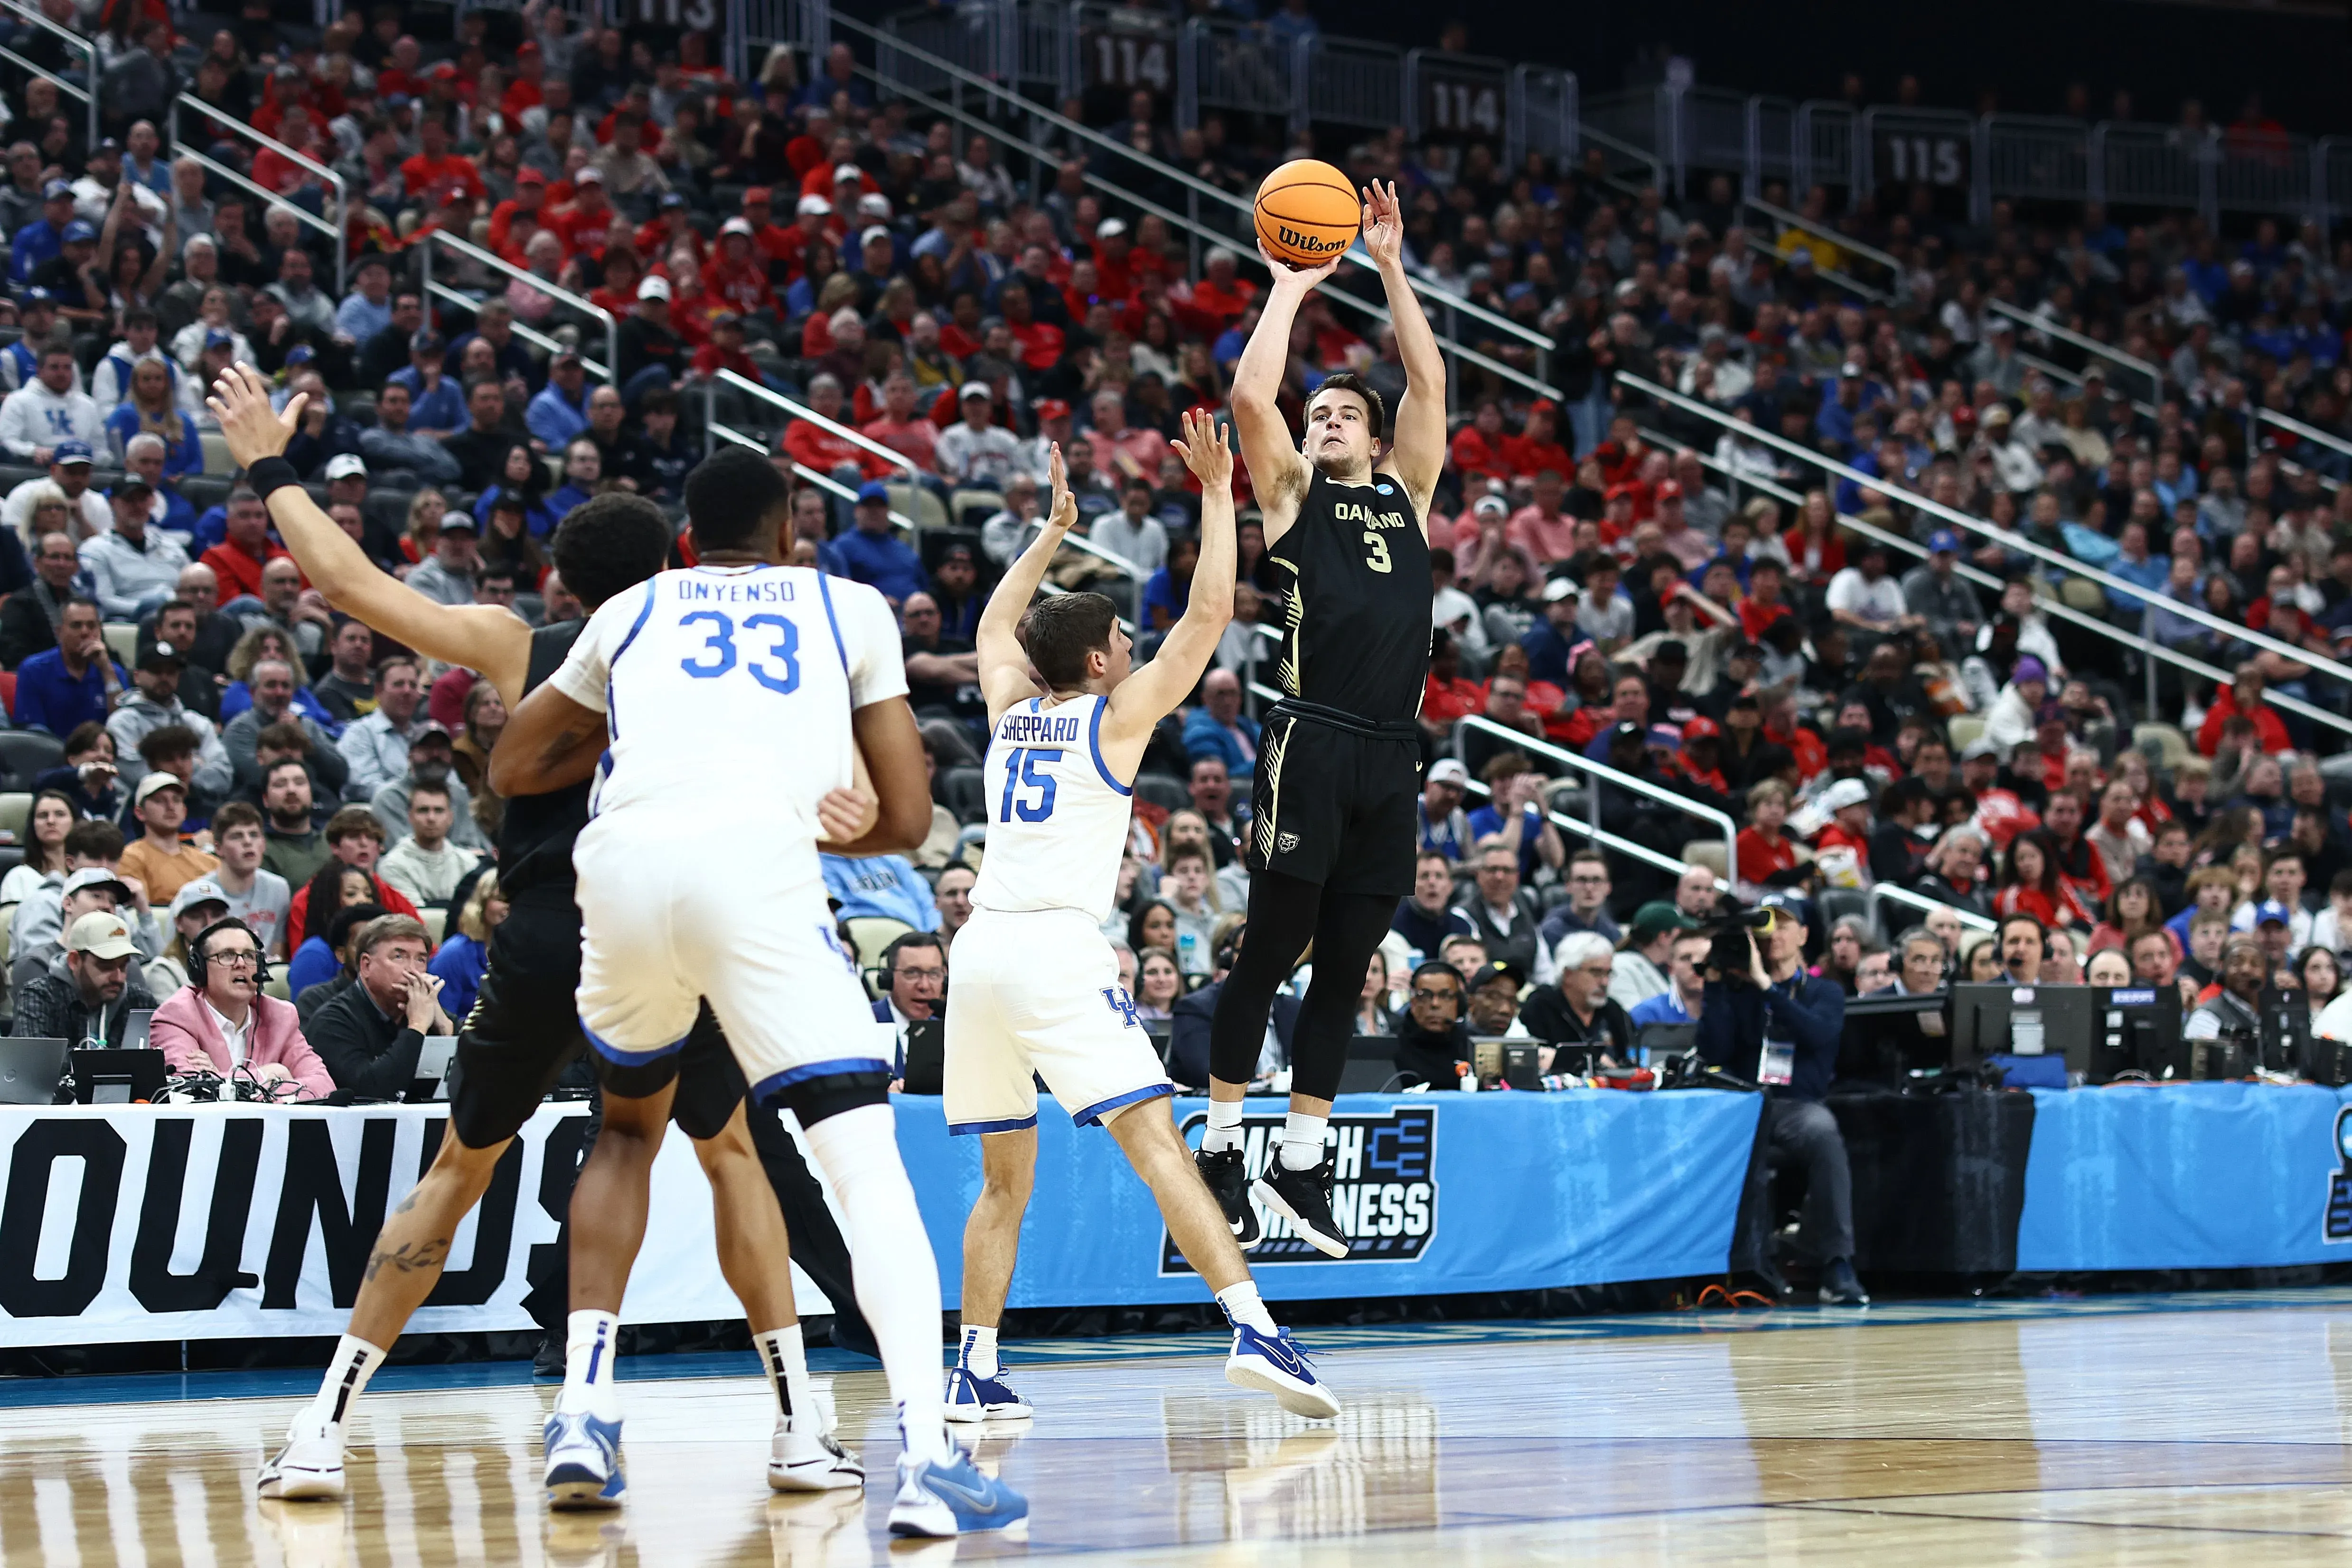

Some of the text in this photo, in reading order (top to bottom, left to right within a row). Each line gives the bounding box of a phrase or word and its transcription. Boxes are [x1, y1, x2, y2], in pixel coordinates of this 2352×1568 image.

[1096, 36, 1169, 89] 114
[1433, 82, 1499, 134] 114
[1890, 137, 1960, 185] 115
[1279, 225, 1347, 252] Wilson
[1335, 503, 1406, 530] OAKLAND
[1363, 531, 1392, 573] 3
[679, 579, 794, 602] ONYENSO
[679, 610, 799, 695] 33
[1002, 715, 1079, 742] SHEPPARD
[1001, 747, 1063, 822] 15
[1099, 986, 1143, 1029] UK
[1242, 1125, 1365, 1180] MCH
[1247, 1182, 1430, 1240] MNESS
